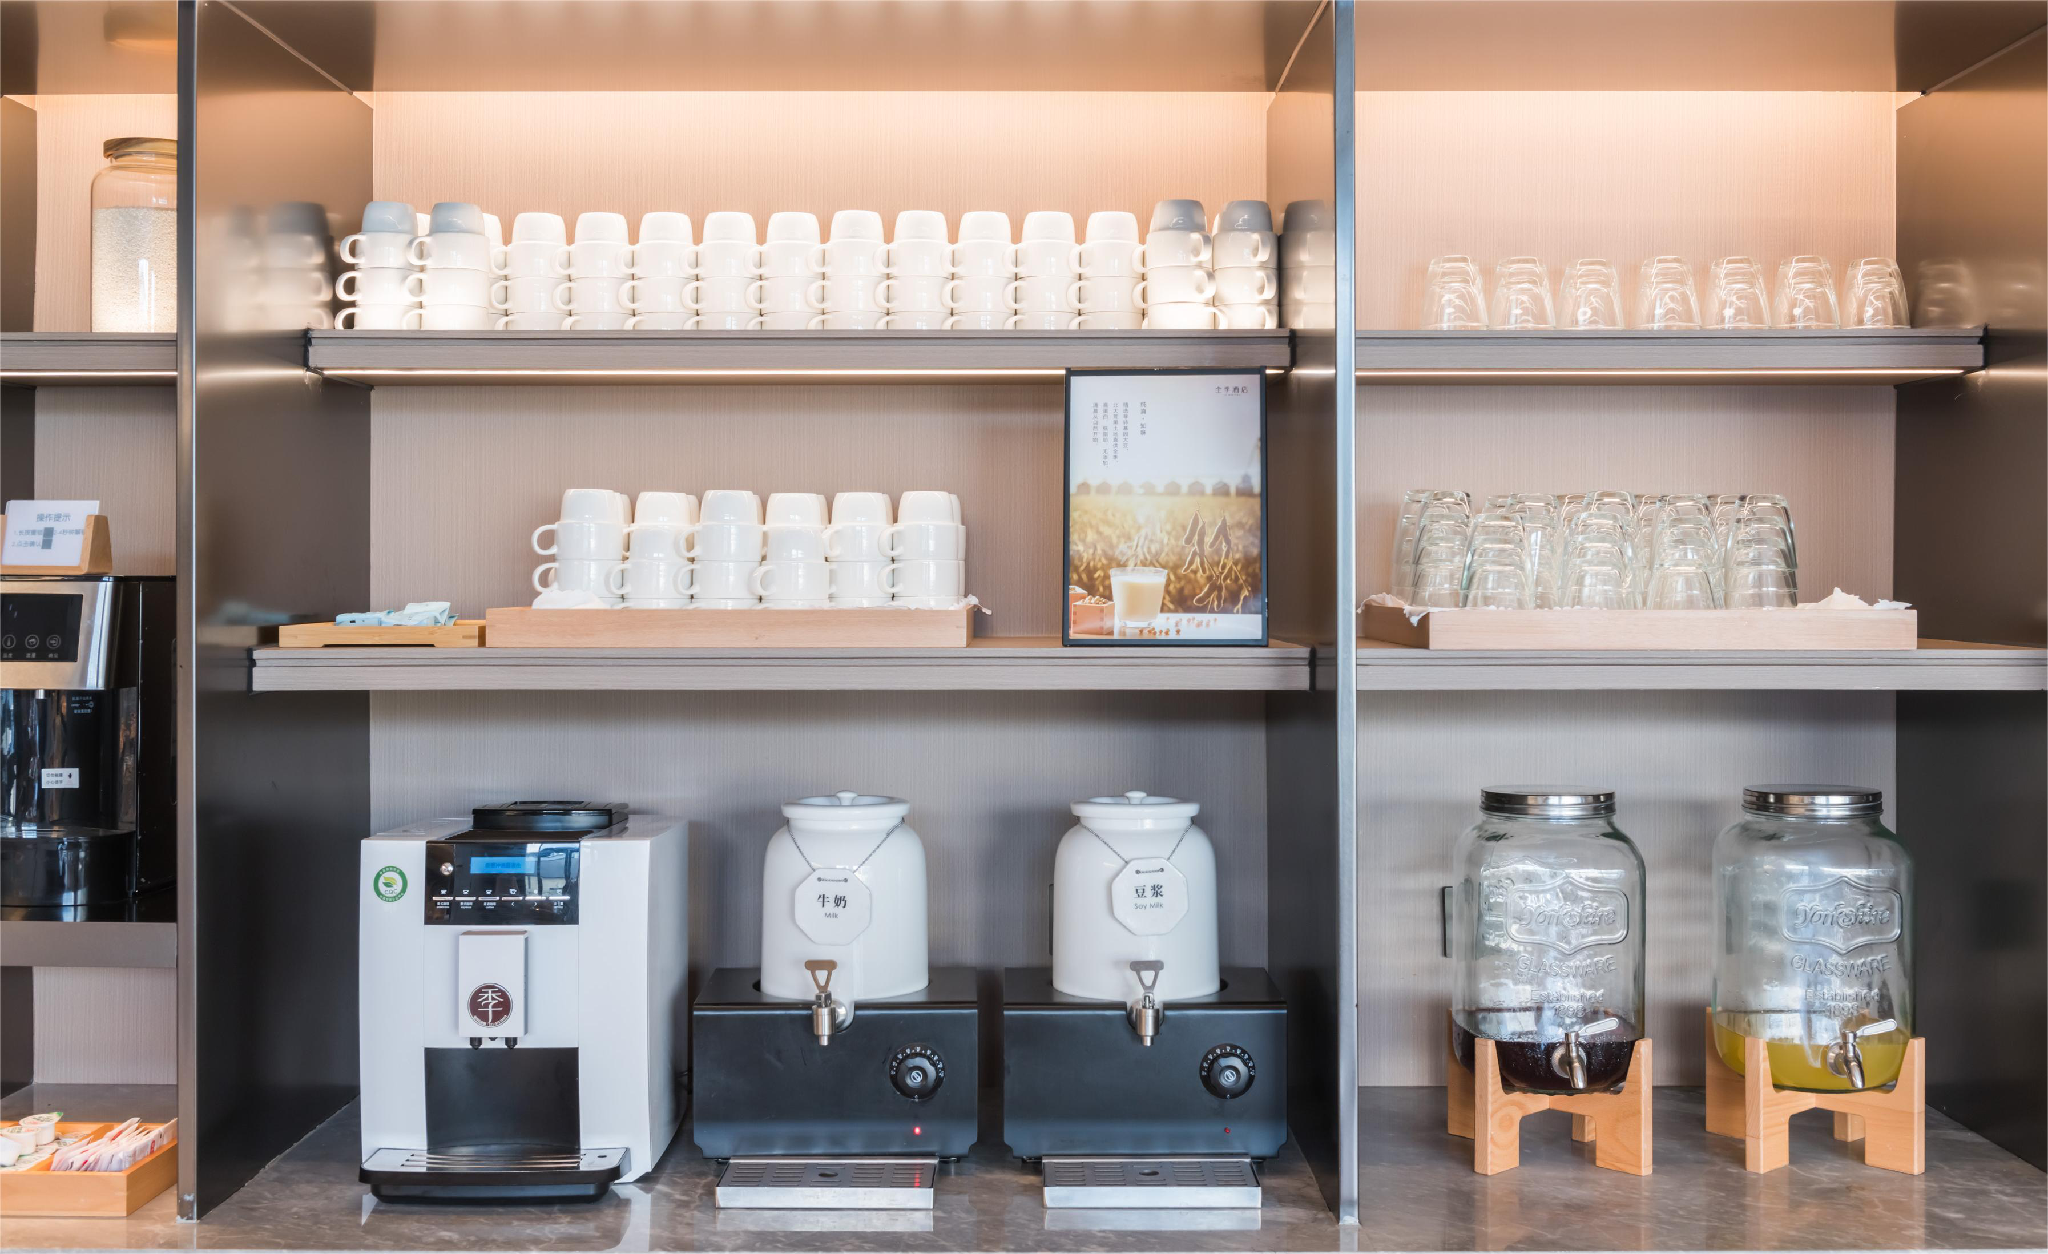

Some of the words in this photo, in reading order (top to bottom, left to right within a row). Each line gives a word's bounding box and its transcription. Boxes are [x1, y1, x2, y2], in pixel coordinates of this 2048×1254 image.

[36, 512, 71, 523] 操作提示
[1133, 884, 1164, 898] 豆浆
[816, 893, 847, 909] 牛奶
[1790, 953, 1892, 978] GLASSWARE
